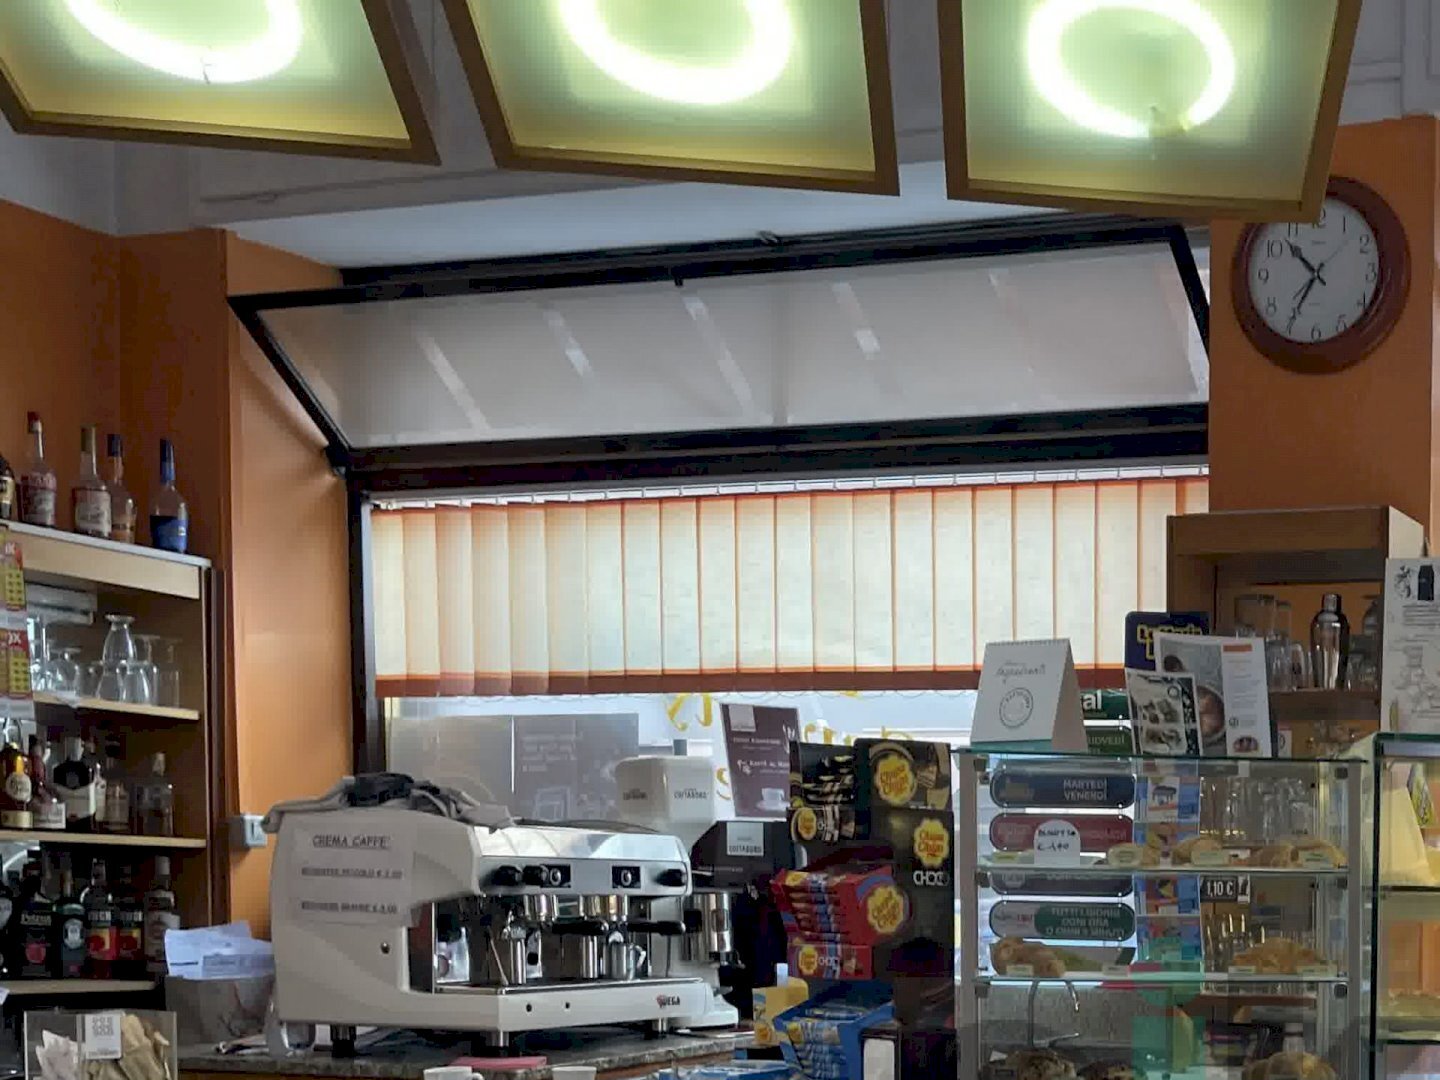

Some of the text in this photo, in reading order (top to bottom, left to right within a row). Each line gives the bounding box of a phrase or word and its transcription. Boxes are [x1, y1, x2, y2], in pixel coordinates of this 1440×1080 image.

[1267, 239, 1283, 258] 10
[1359, 234, 1371, 254] 2
[1257, 268, 1270, 285] 9
[1365, 262, 1378, 283] 3
[1265, 296, 1278, 317] 8
[1310, 323, 1322, 342] 6
